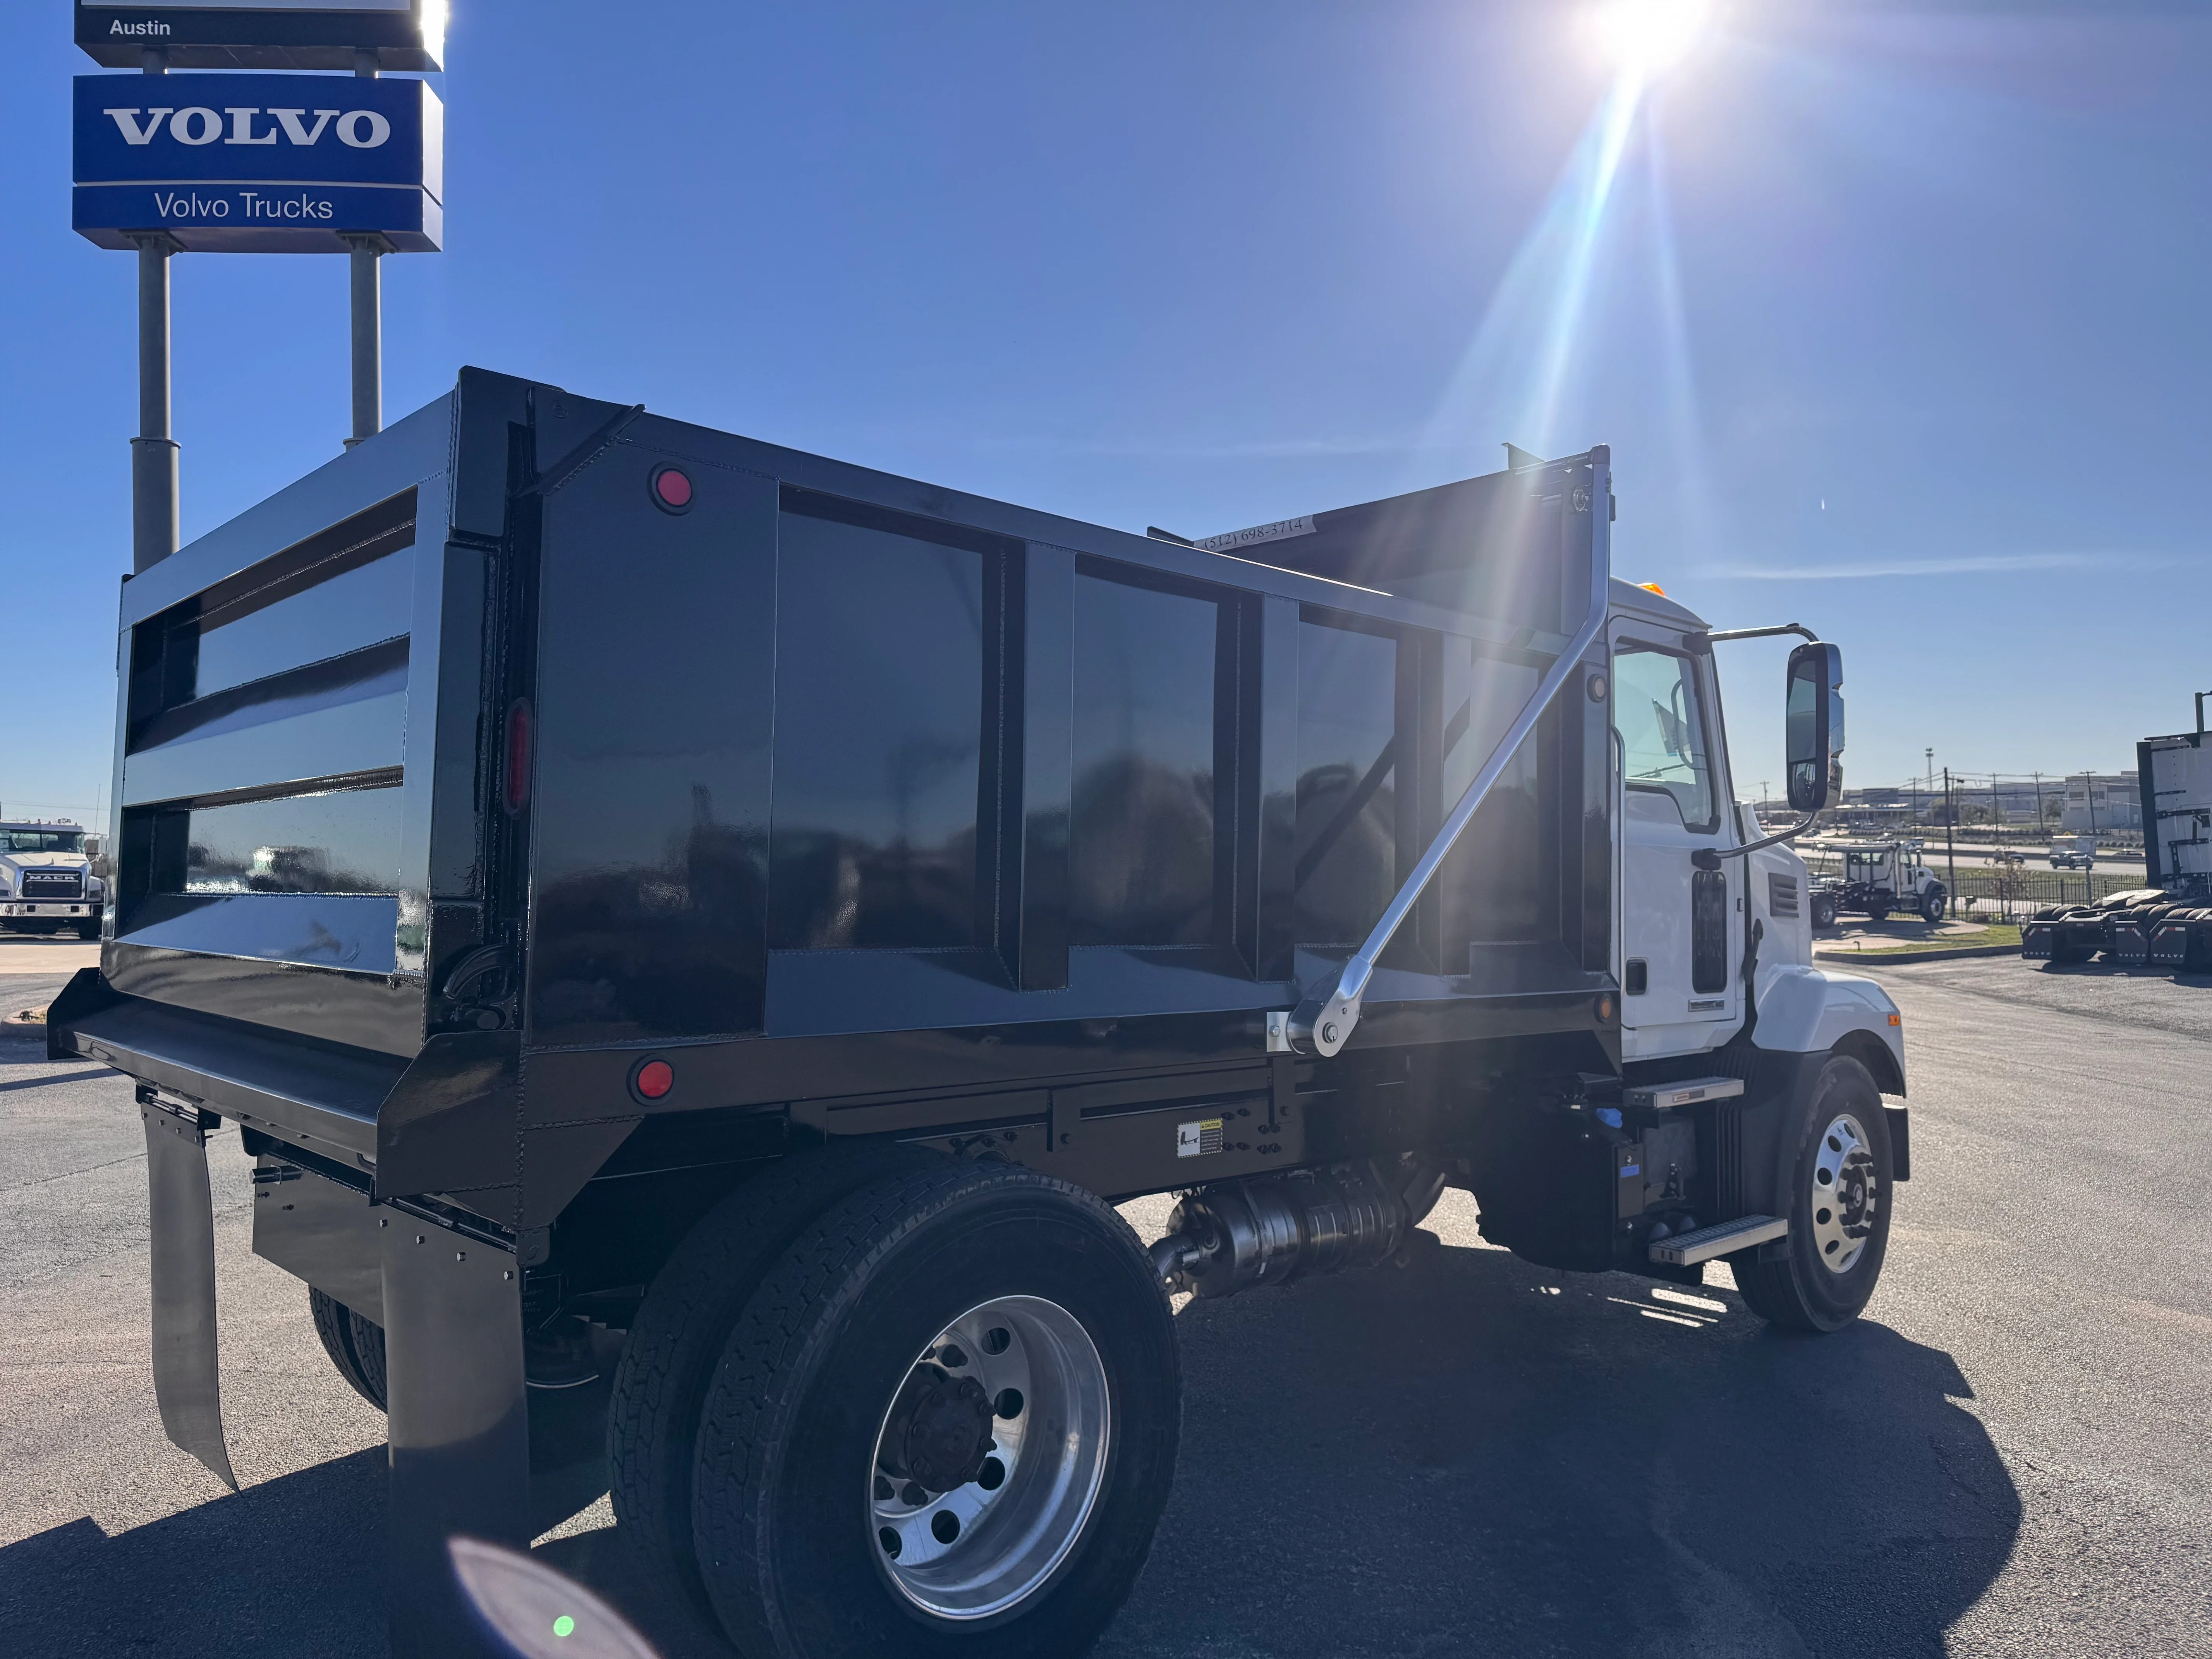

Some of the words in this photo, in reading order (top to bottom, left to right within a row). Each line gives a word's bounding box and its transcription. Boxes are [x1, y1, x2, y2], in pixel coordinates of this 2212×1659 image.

[110, 19, 170, 35] Austin
[103, 107, 390, 148] VOLVO
[155, 192, 229, 217] Volvo
[239, 192, 333, 218] Trucks
[1205, 533, 1237, 549] (512)
[1241, 519, 1302, 541] 698-3714
